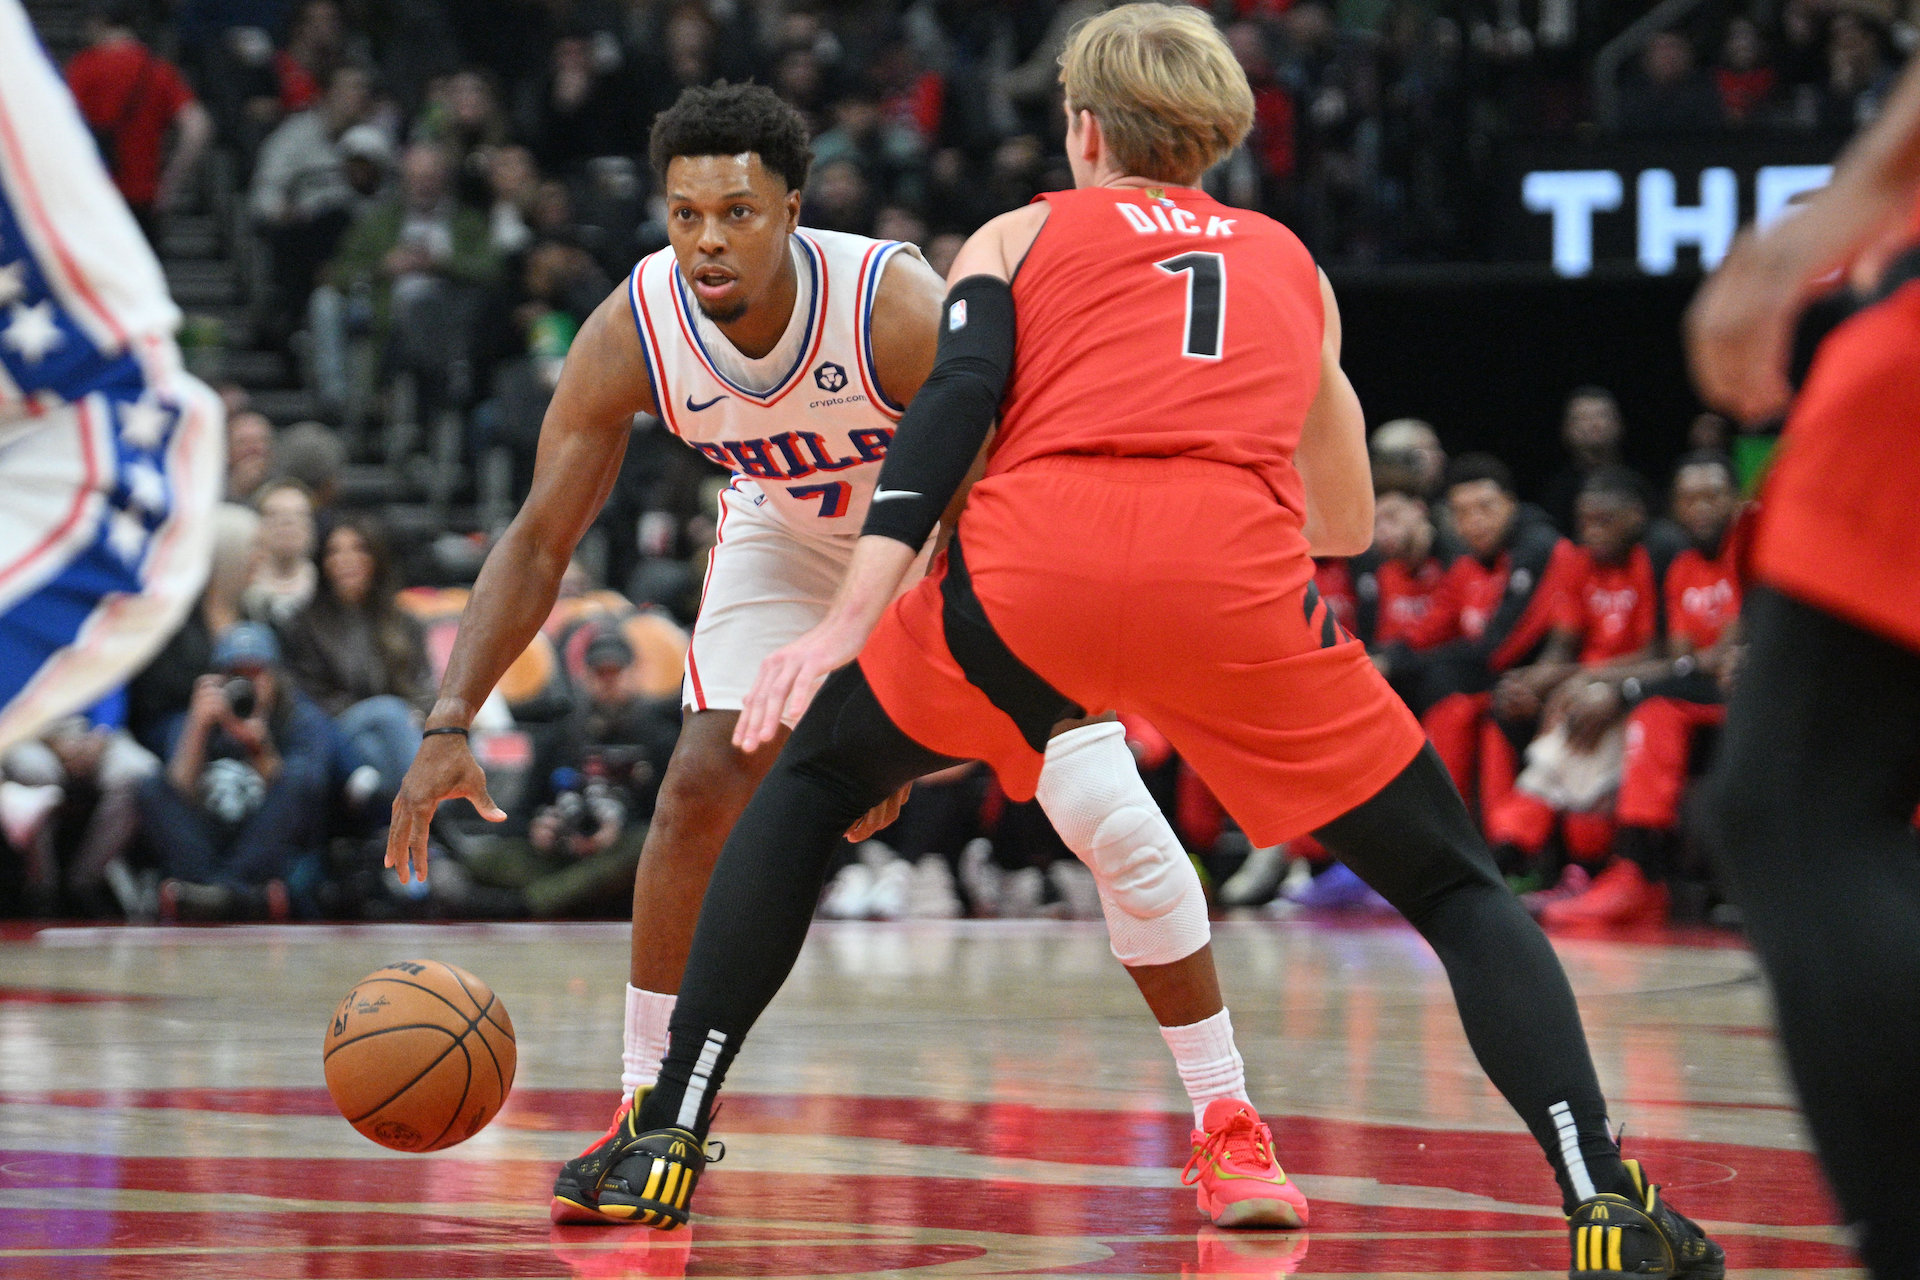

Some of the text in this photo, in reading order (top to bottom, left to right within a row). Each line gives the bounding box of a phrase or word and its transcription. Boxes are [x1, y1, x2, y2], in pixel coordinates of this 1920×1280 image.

[1115, 202, 1237, 236] DICK
[1153, 251, 1226, 359] 1
[809, 394, 868, 408] crypto.com
[786, 481, 852, 517] 7
